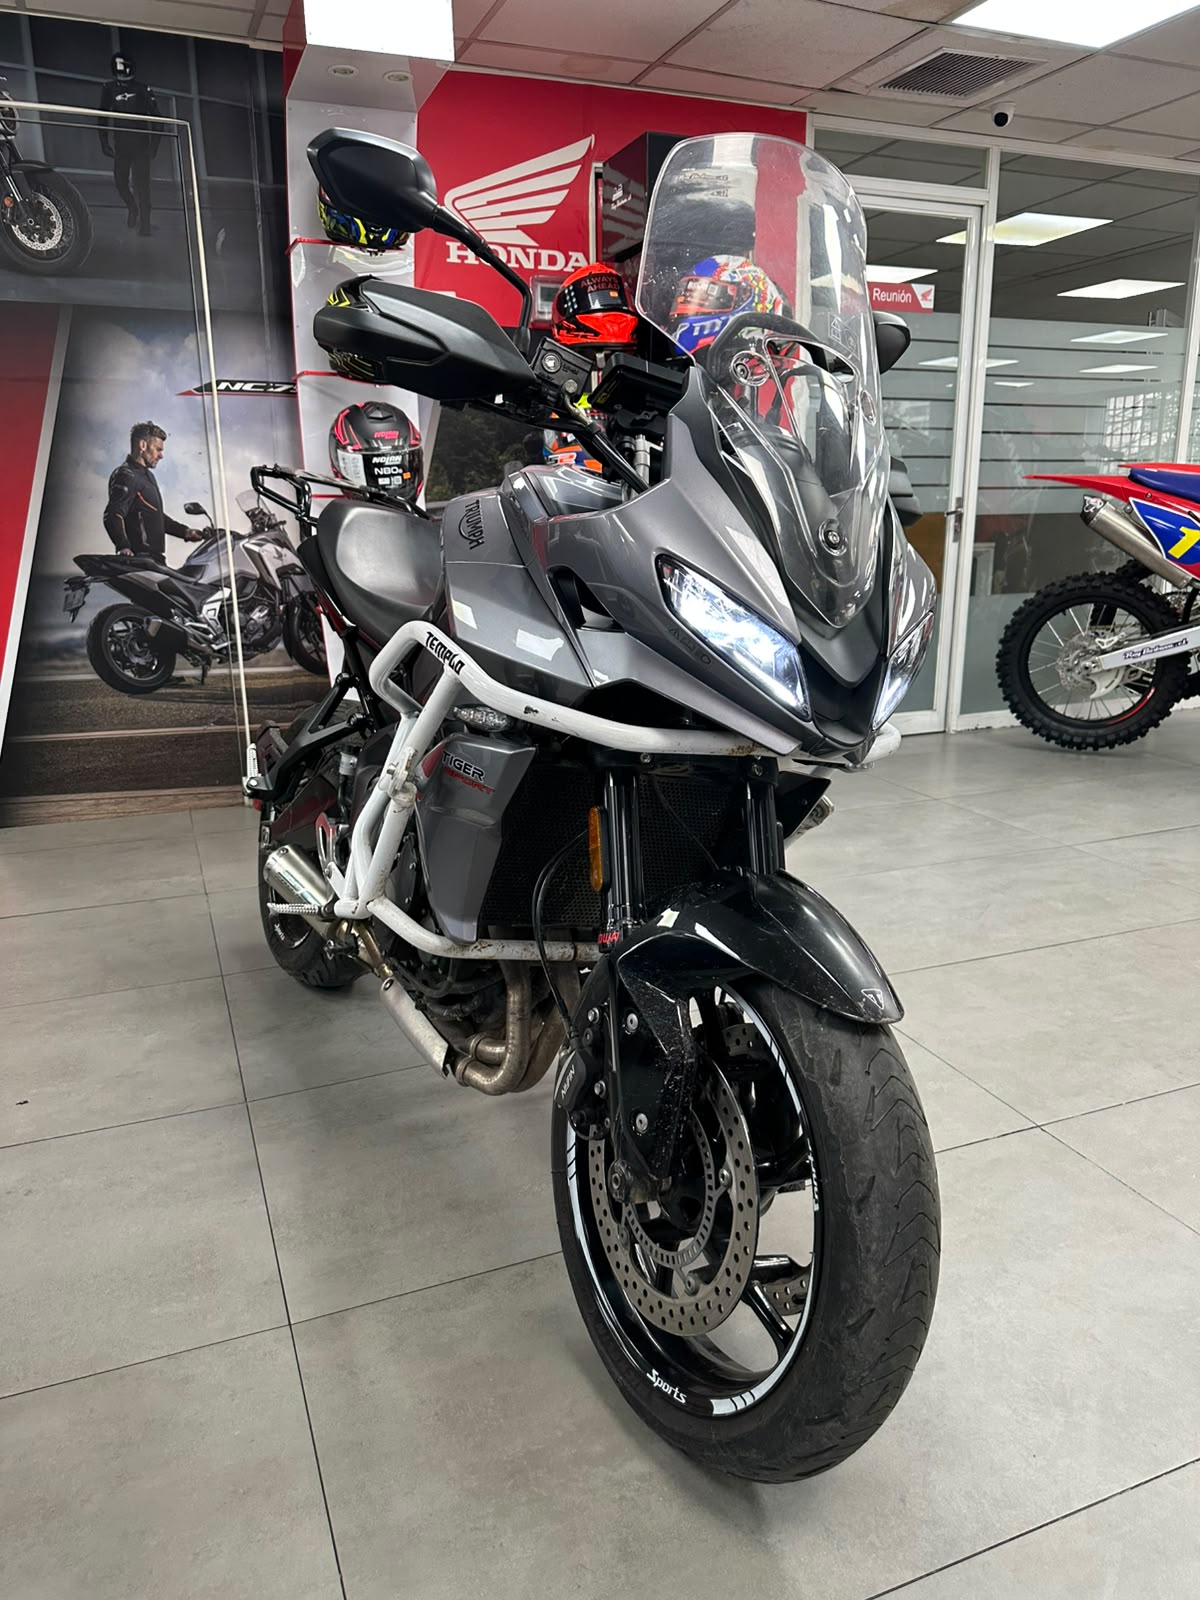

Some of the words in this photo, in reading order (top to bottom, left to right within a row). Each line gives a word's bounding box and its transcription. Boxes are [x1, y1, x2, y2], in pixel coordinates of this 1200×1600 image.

[872, 287, 912, 304] Reunión
[217, 381, 297, 393] NC7
[372, 454, 402, 466] NOLAN
[459, 498, 485, 551] TRIUMPH
[441, 751, 485, 782] TIGER
[646, 1368, 688, 1405] Sports
